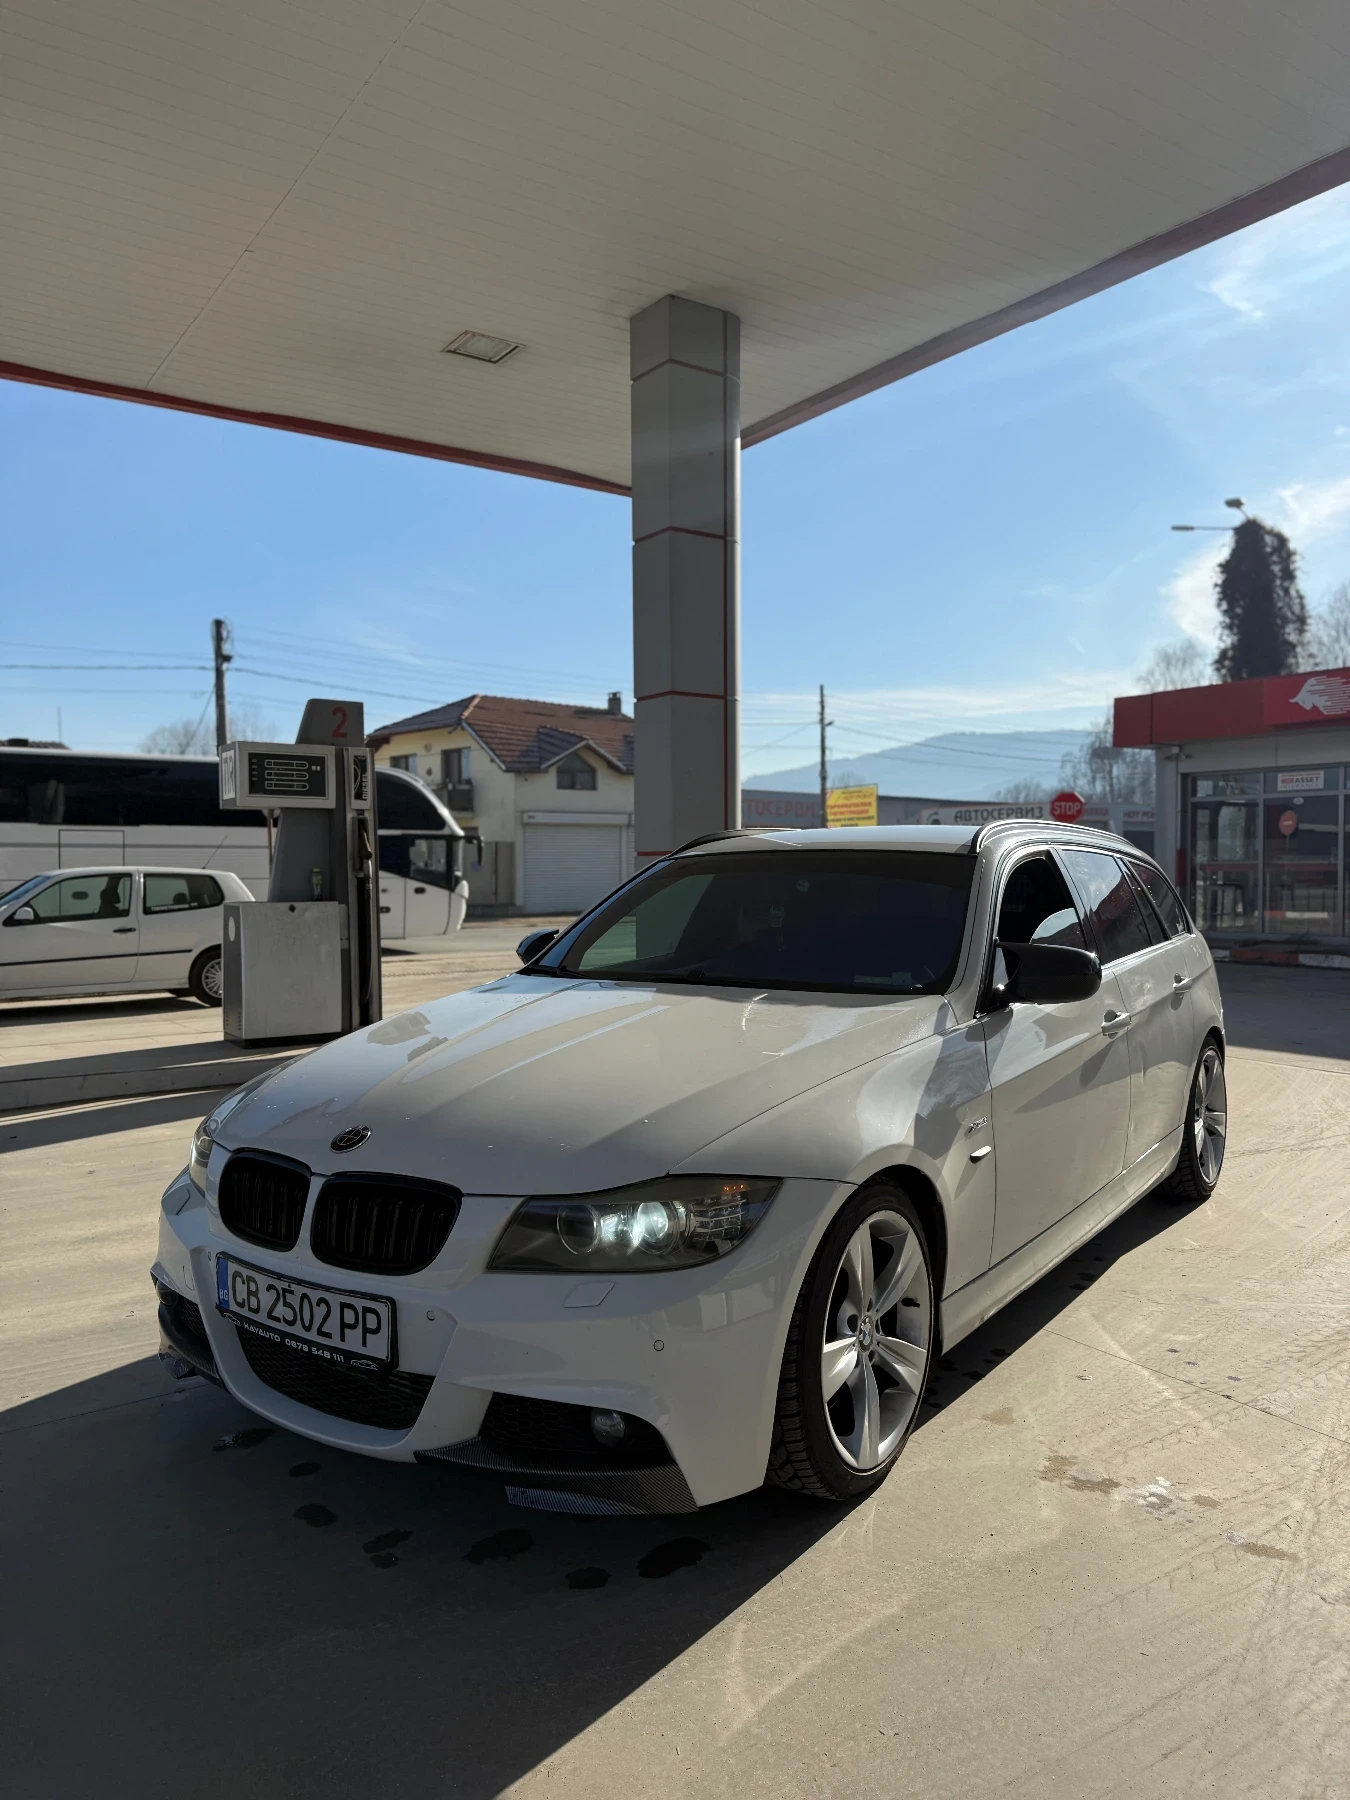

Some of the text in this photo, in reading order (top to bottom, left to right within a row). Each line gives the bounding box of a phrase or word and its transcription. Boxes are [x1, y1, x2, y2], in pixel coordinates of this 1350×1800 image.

[332, 707, 348, 738] 2
[954, 806, 1044, 822] АВТОСЕРВИЗ
[1053, 801, 1080, 815] STOP
[219, 1288, 229, 1300] BG
[231, 1270, 382, 1348] CB 2502 PP
[284, 1338, 309, 1352] 0878
[333, 1353, 344, 1363] 111
